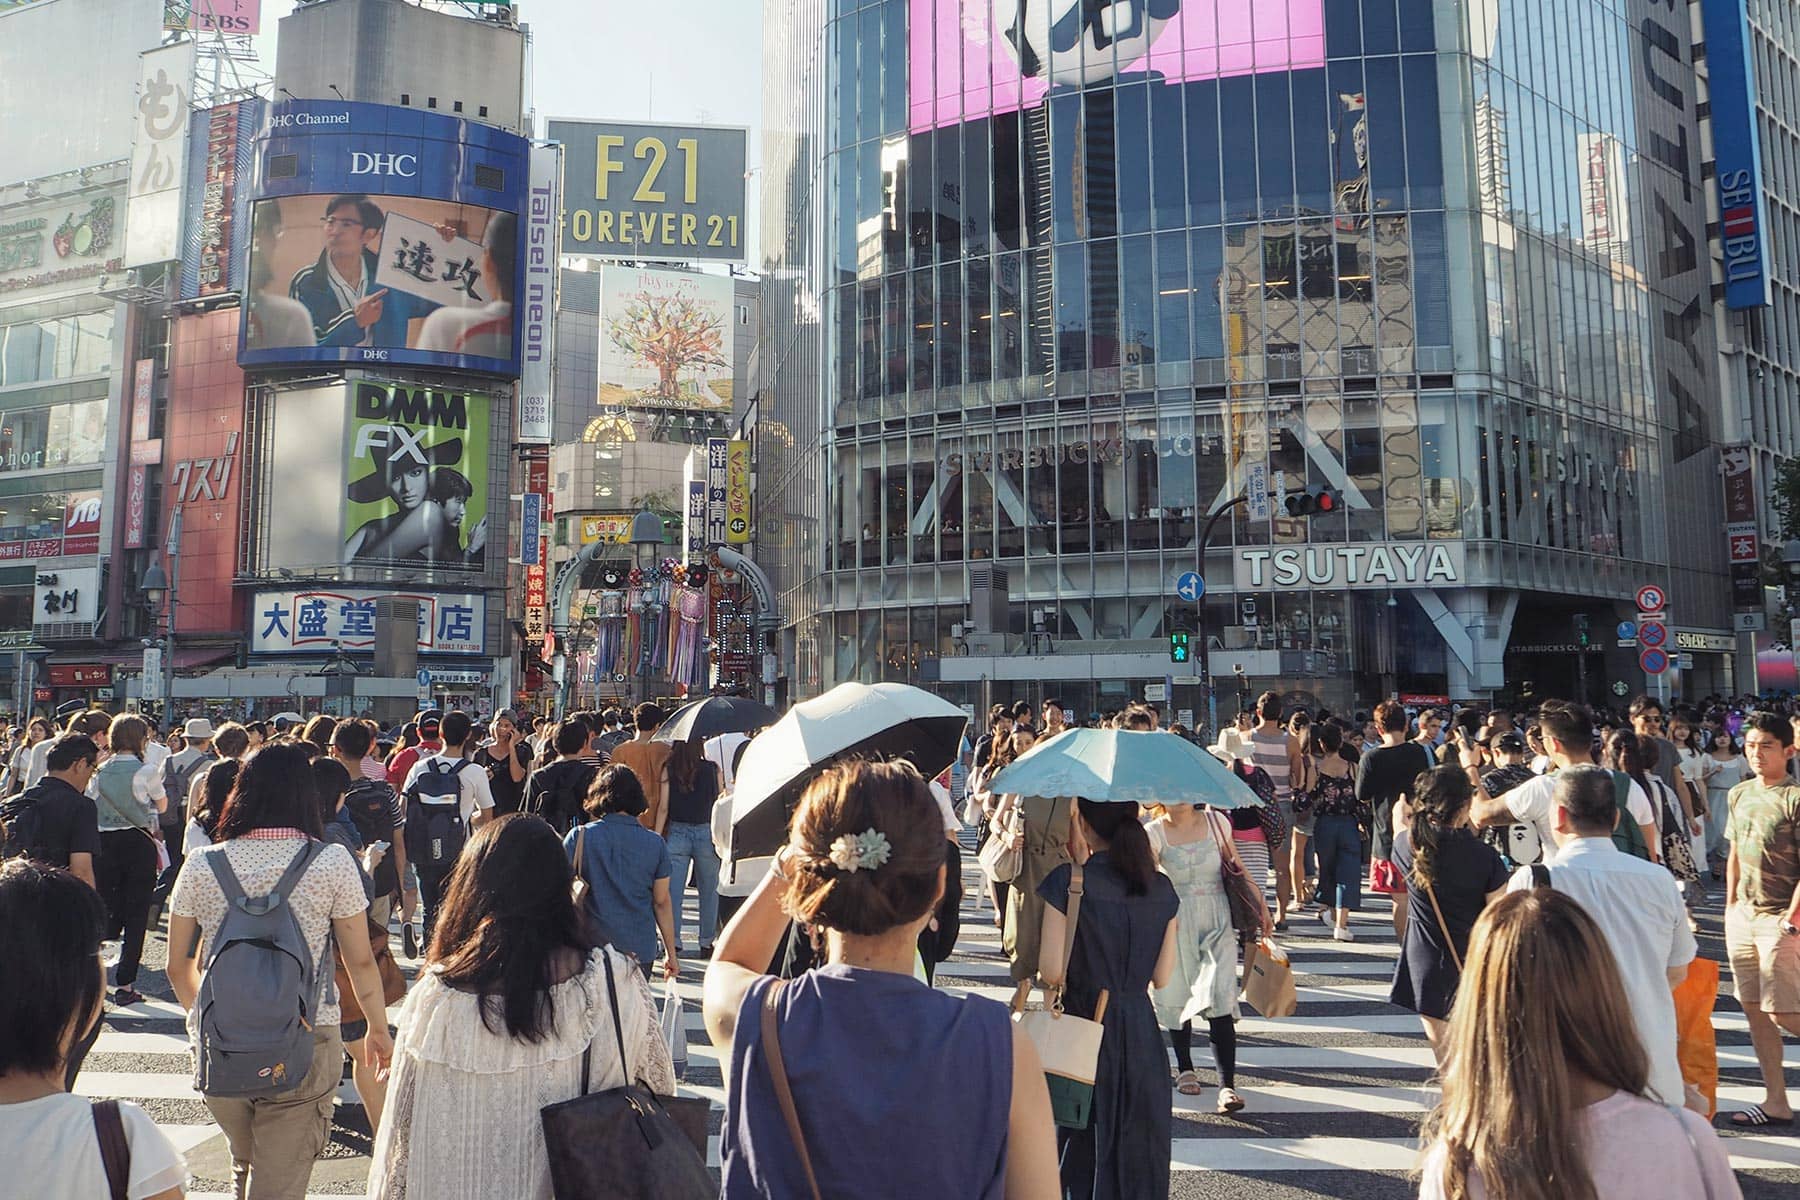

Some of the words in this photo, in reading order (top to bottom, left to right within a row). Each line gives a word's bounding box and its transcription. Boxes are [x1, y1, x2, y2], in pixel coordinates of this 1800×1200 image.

[200, 13, 250, 30] TBS
[268, 113, 294, 127] DHC
[295, 112, 350, 126] Channel
[350, 152, 417, 177] DHC
[595, 134, 699, 204] F21
[526, 181, 551, 273] Taisei
[707, 215, 738, 247] 21
[391, 235, 483, 302] 速攻
[526, 282, 544, 362] neon
[363, 349, 388, 360] DHC
[355, 383, 468, 430] DMM
[354, 423, 429, 465] FX
[946, 438, 1132, 476] STARBUCKS
[67, 497, 101, 528] JTB
[709, 445, 727, 544] 洋服の青山
[731, 520, 745, 532] 4F
[1242, 544, 1458, 586] TSUTAYA
[1734, 538, 1753, 557] 本
[261, 599, 474, 641] 大盛堂店
